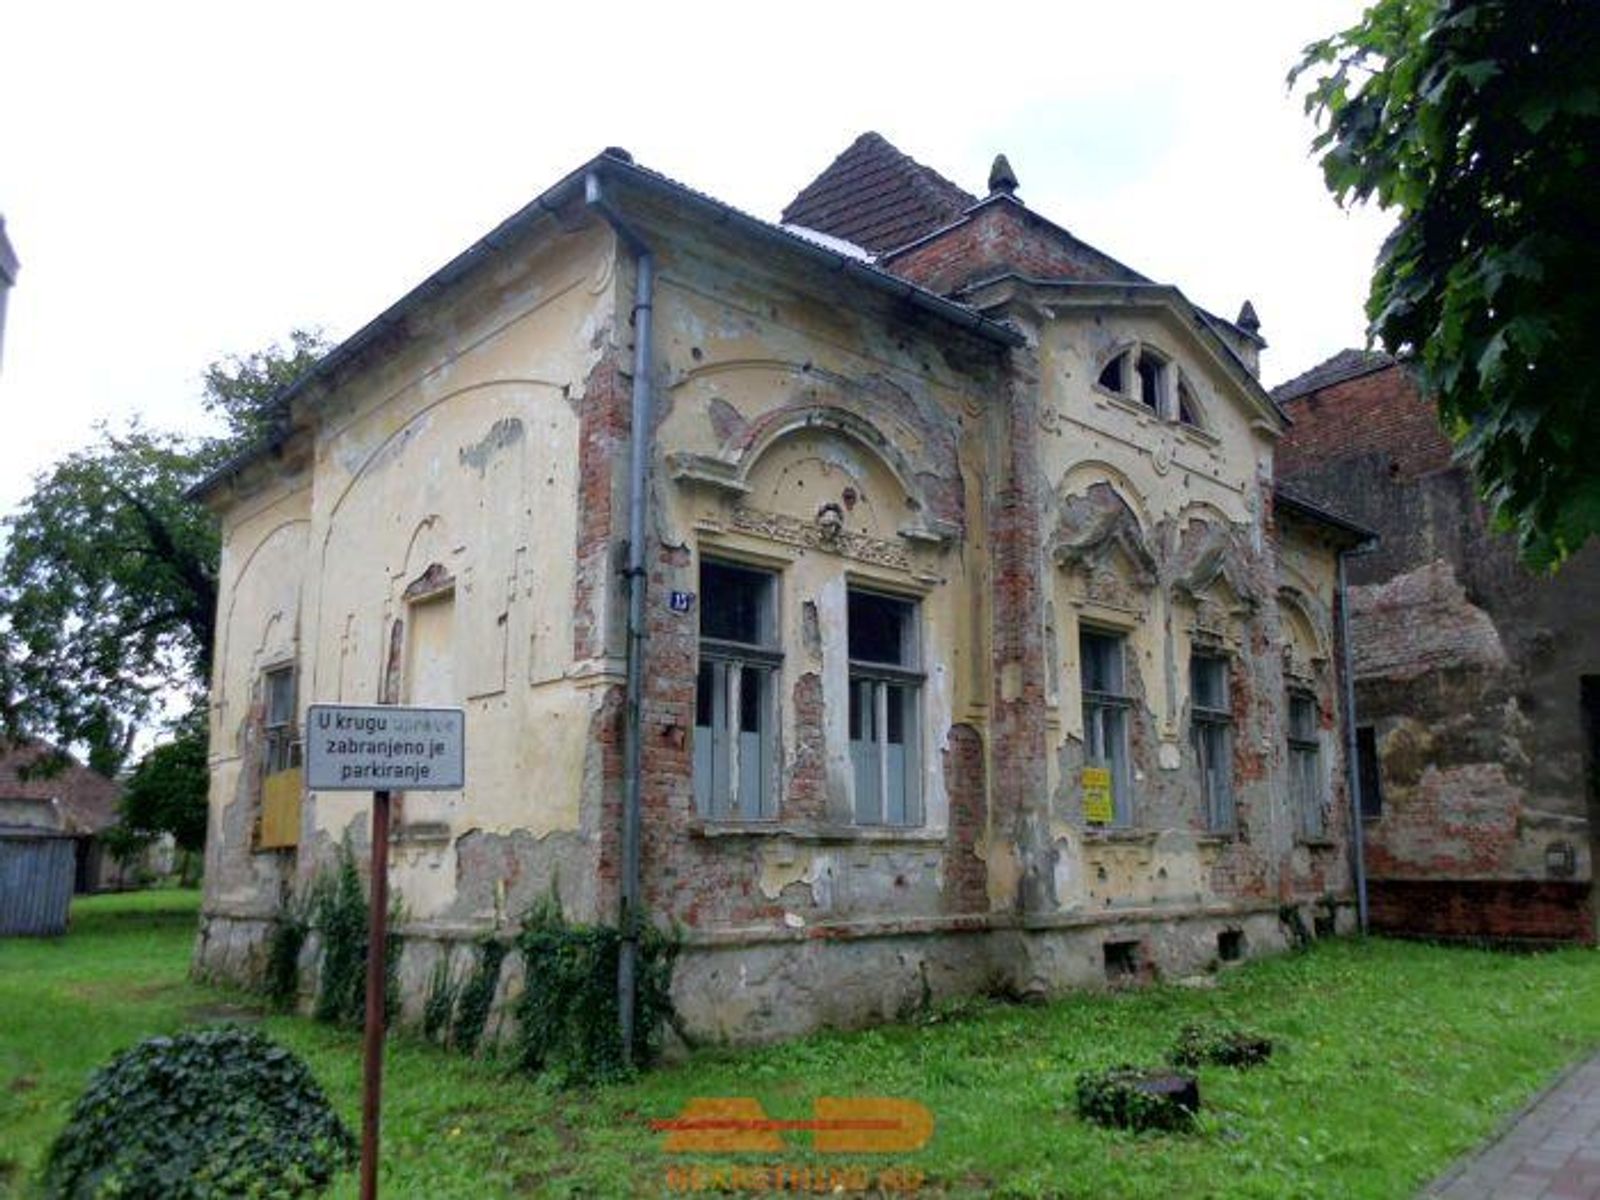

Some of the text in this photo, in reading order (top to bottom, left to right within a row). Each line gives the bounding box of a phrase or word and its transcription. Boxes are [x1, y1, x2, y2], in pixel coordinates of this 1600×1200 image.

[319, 713, 331, 730] U
[336, 714, 387, 734] krugu
[326, 739, 445, 759] zabranjeno je
[341, 760, 430, 781] parkiranje
